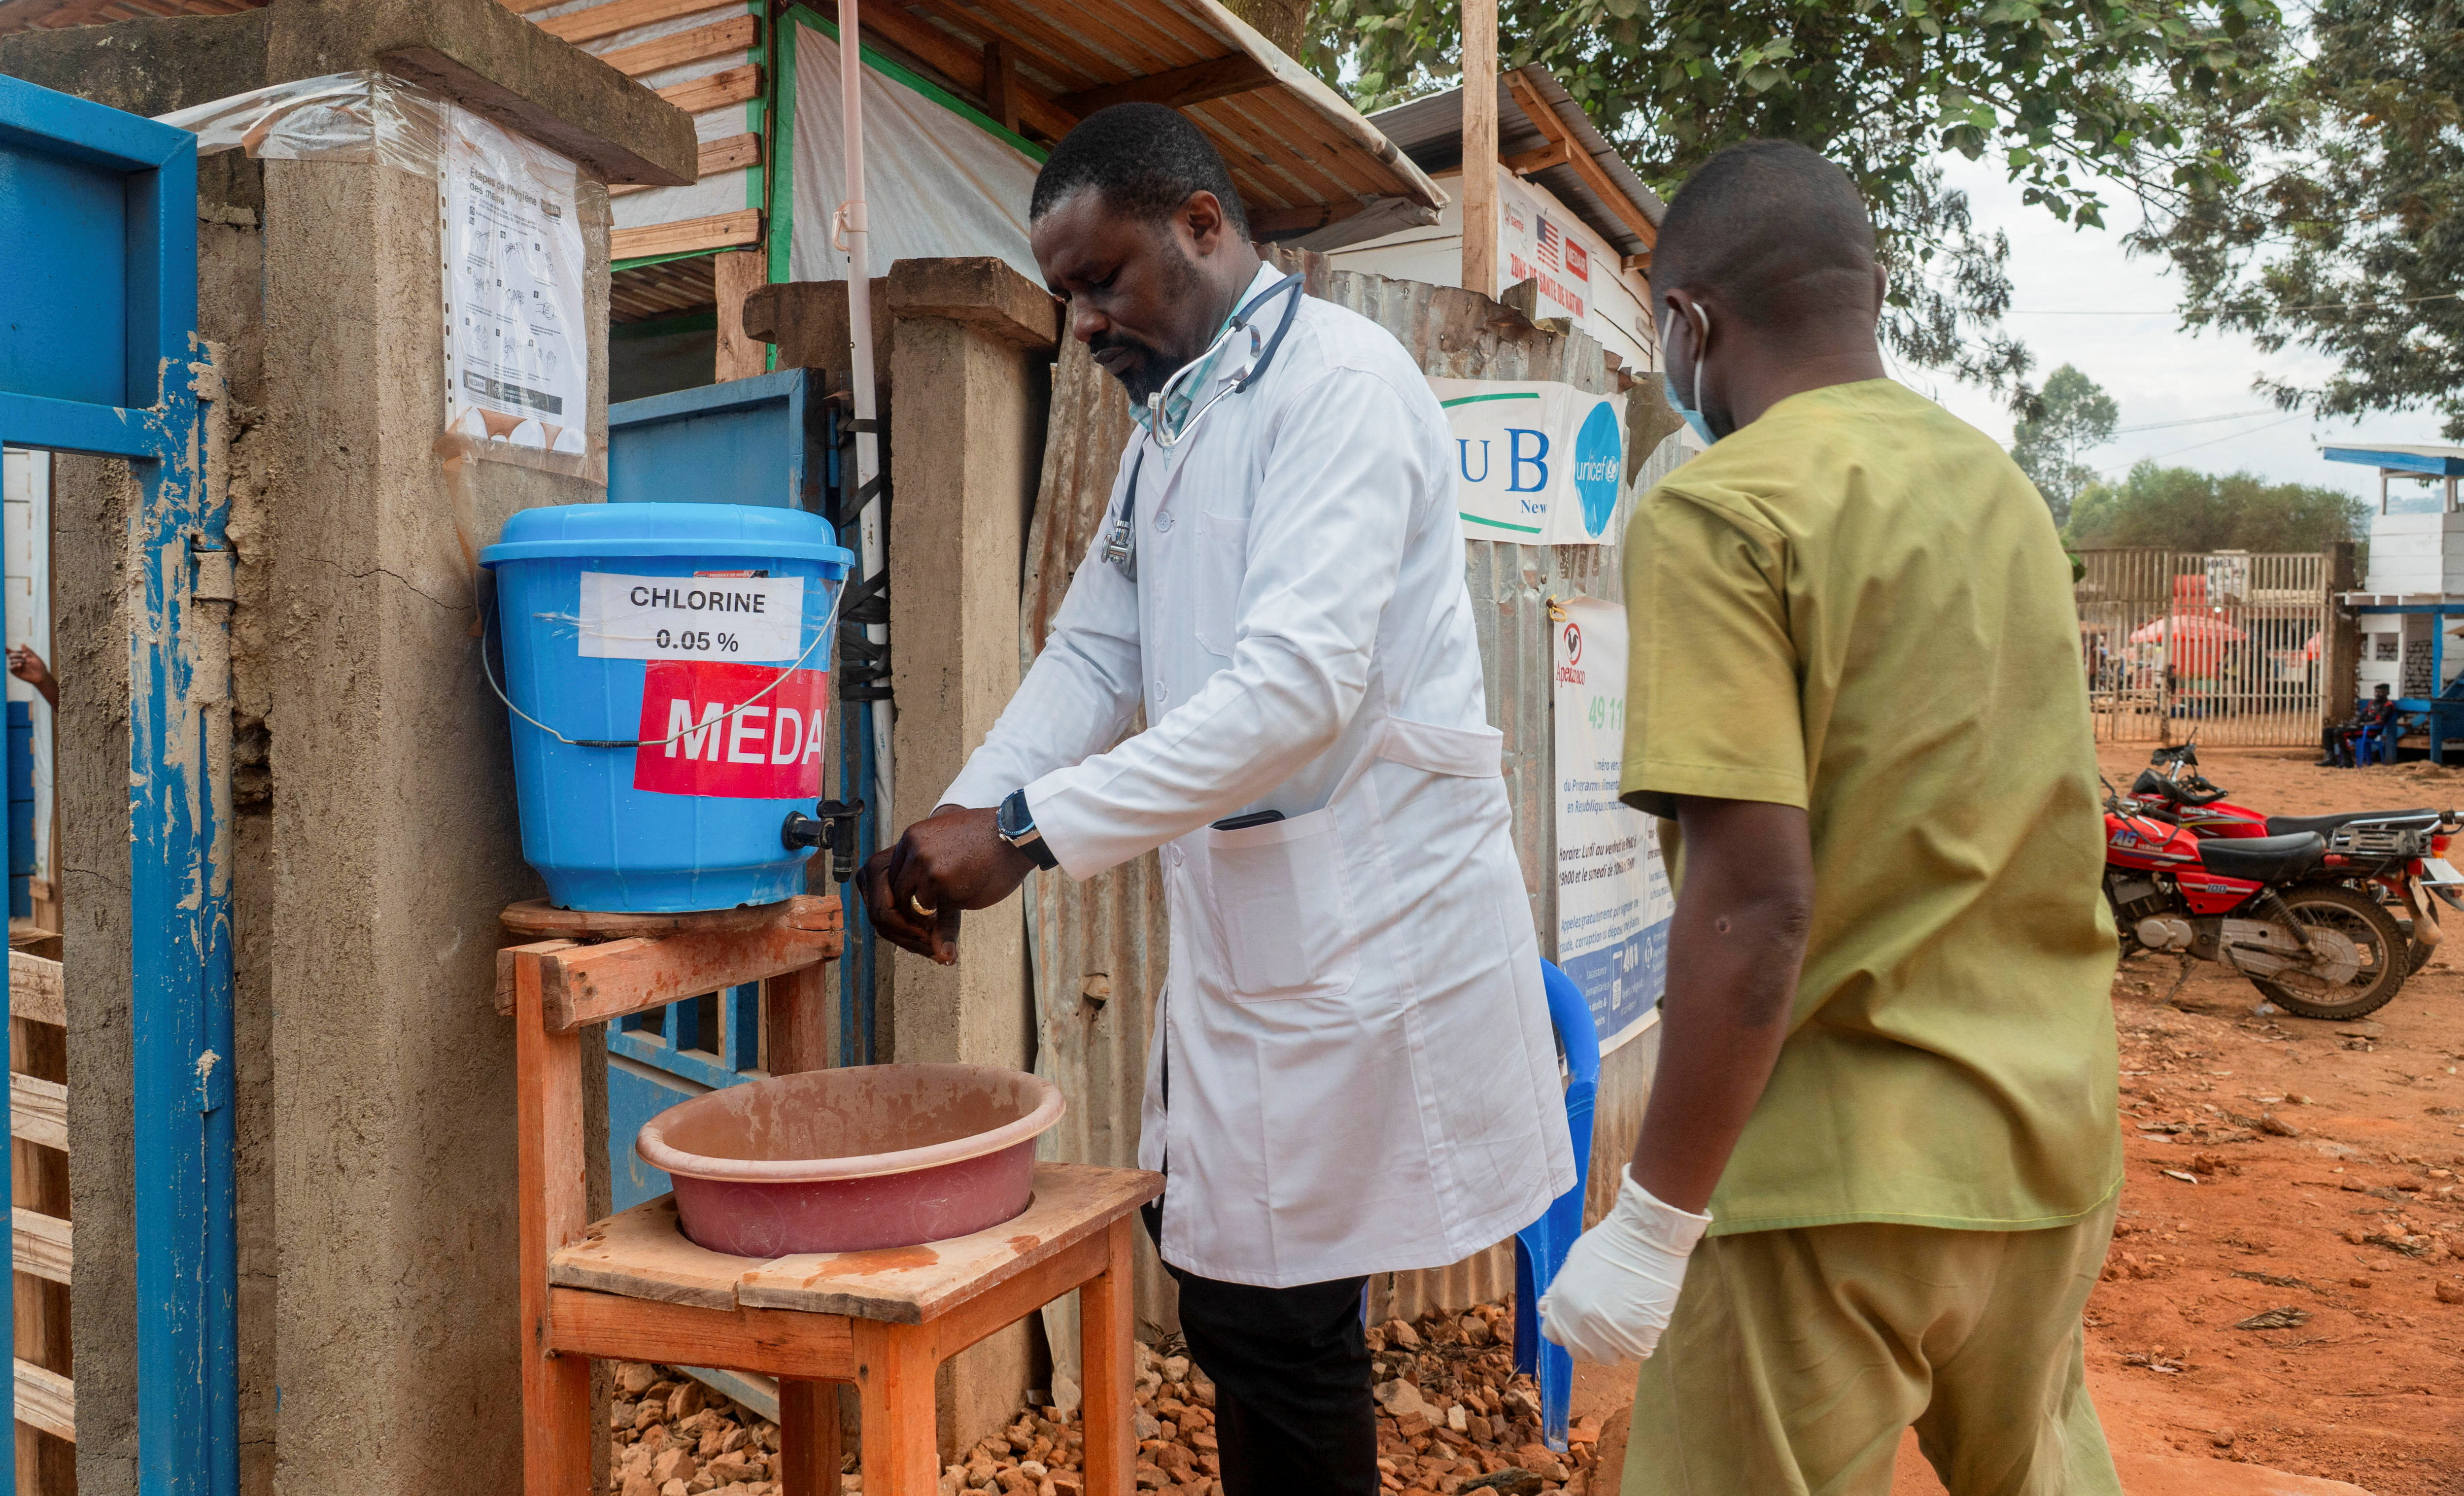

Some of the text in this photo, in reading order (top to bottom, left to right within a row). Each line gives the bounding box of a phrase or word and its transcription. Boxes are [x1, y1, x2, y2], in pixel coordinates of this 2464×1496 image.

[470, 182, 505, 205] des mains
[497, 180, 505, 192] de
[507, 184, 537, 205] l'hygiène
[1510, 252, 1526, 281] ZONE
[1539, 271, 1557, 302] SANTE
[1558, 283, 1565, 306] DE
[469, 378, 484, 388] MEDAIR
[1576, 455, 1607, 482] unicef
[1521, 500, 1547, 514] New
[630, 586, 765, 613] CHLORINE
[656, 629, 738, 652] 0.05 %
[1589, 695, 1623, 730] 49 11
[665, 698, 827, 765] MEDA
[1564, 779, 1571, 792] du
[1567, 803, 1574, 813] en
[2109, 830, 2138, 848] AG
[1559, 846, 1581, 862] Horaire:
[1596, 846, 1605, 856] au
[1559, 870, 1574, 886] 19h00
[1575, 870, 1581, 883] et
[1582, 868, 1587, 882] le
[1608, 863, 1612, 877] de
[2206, 884, 2227, 893] 100
[1561, 915, 1580, 934] Appelez
[1581, 908, 1612, 930] gratuitement
[1575, 931, 1602, 948] corruption
